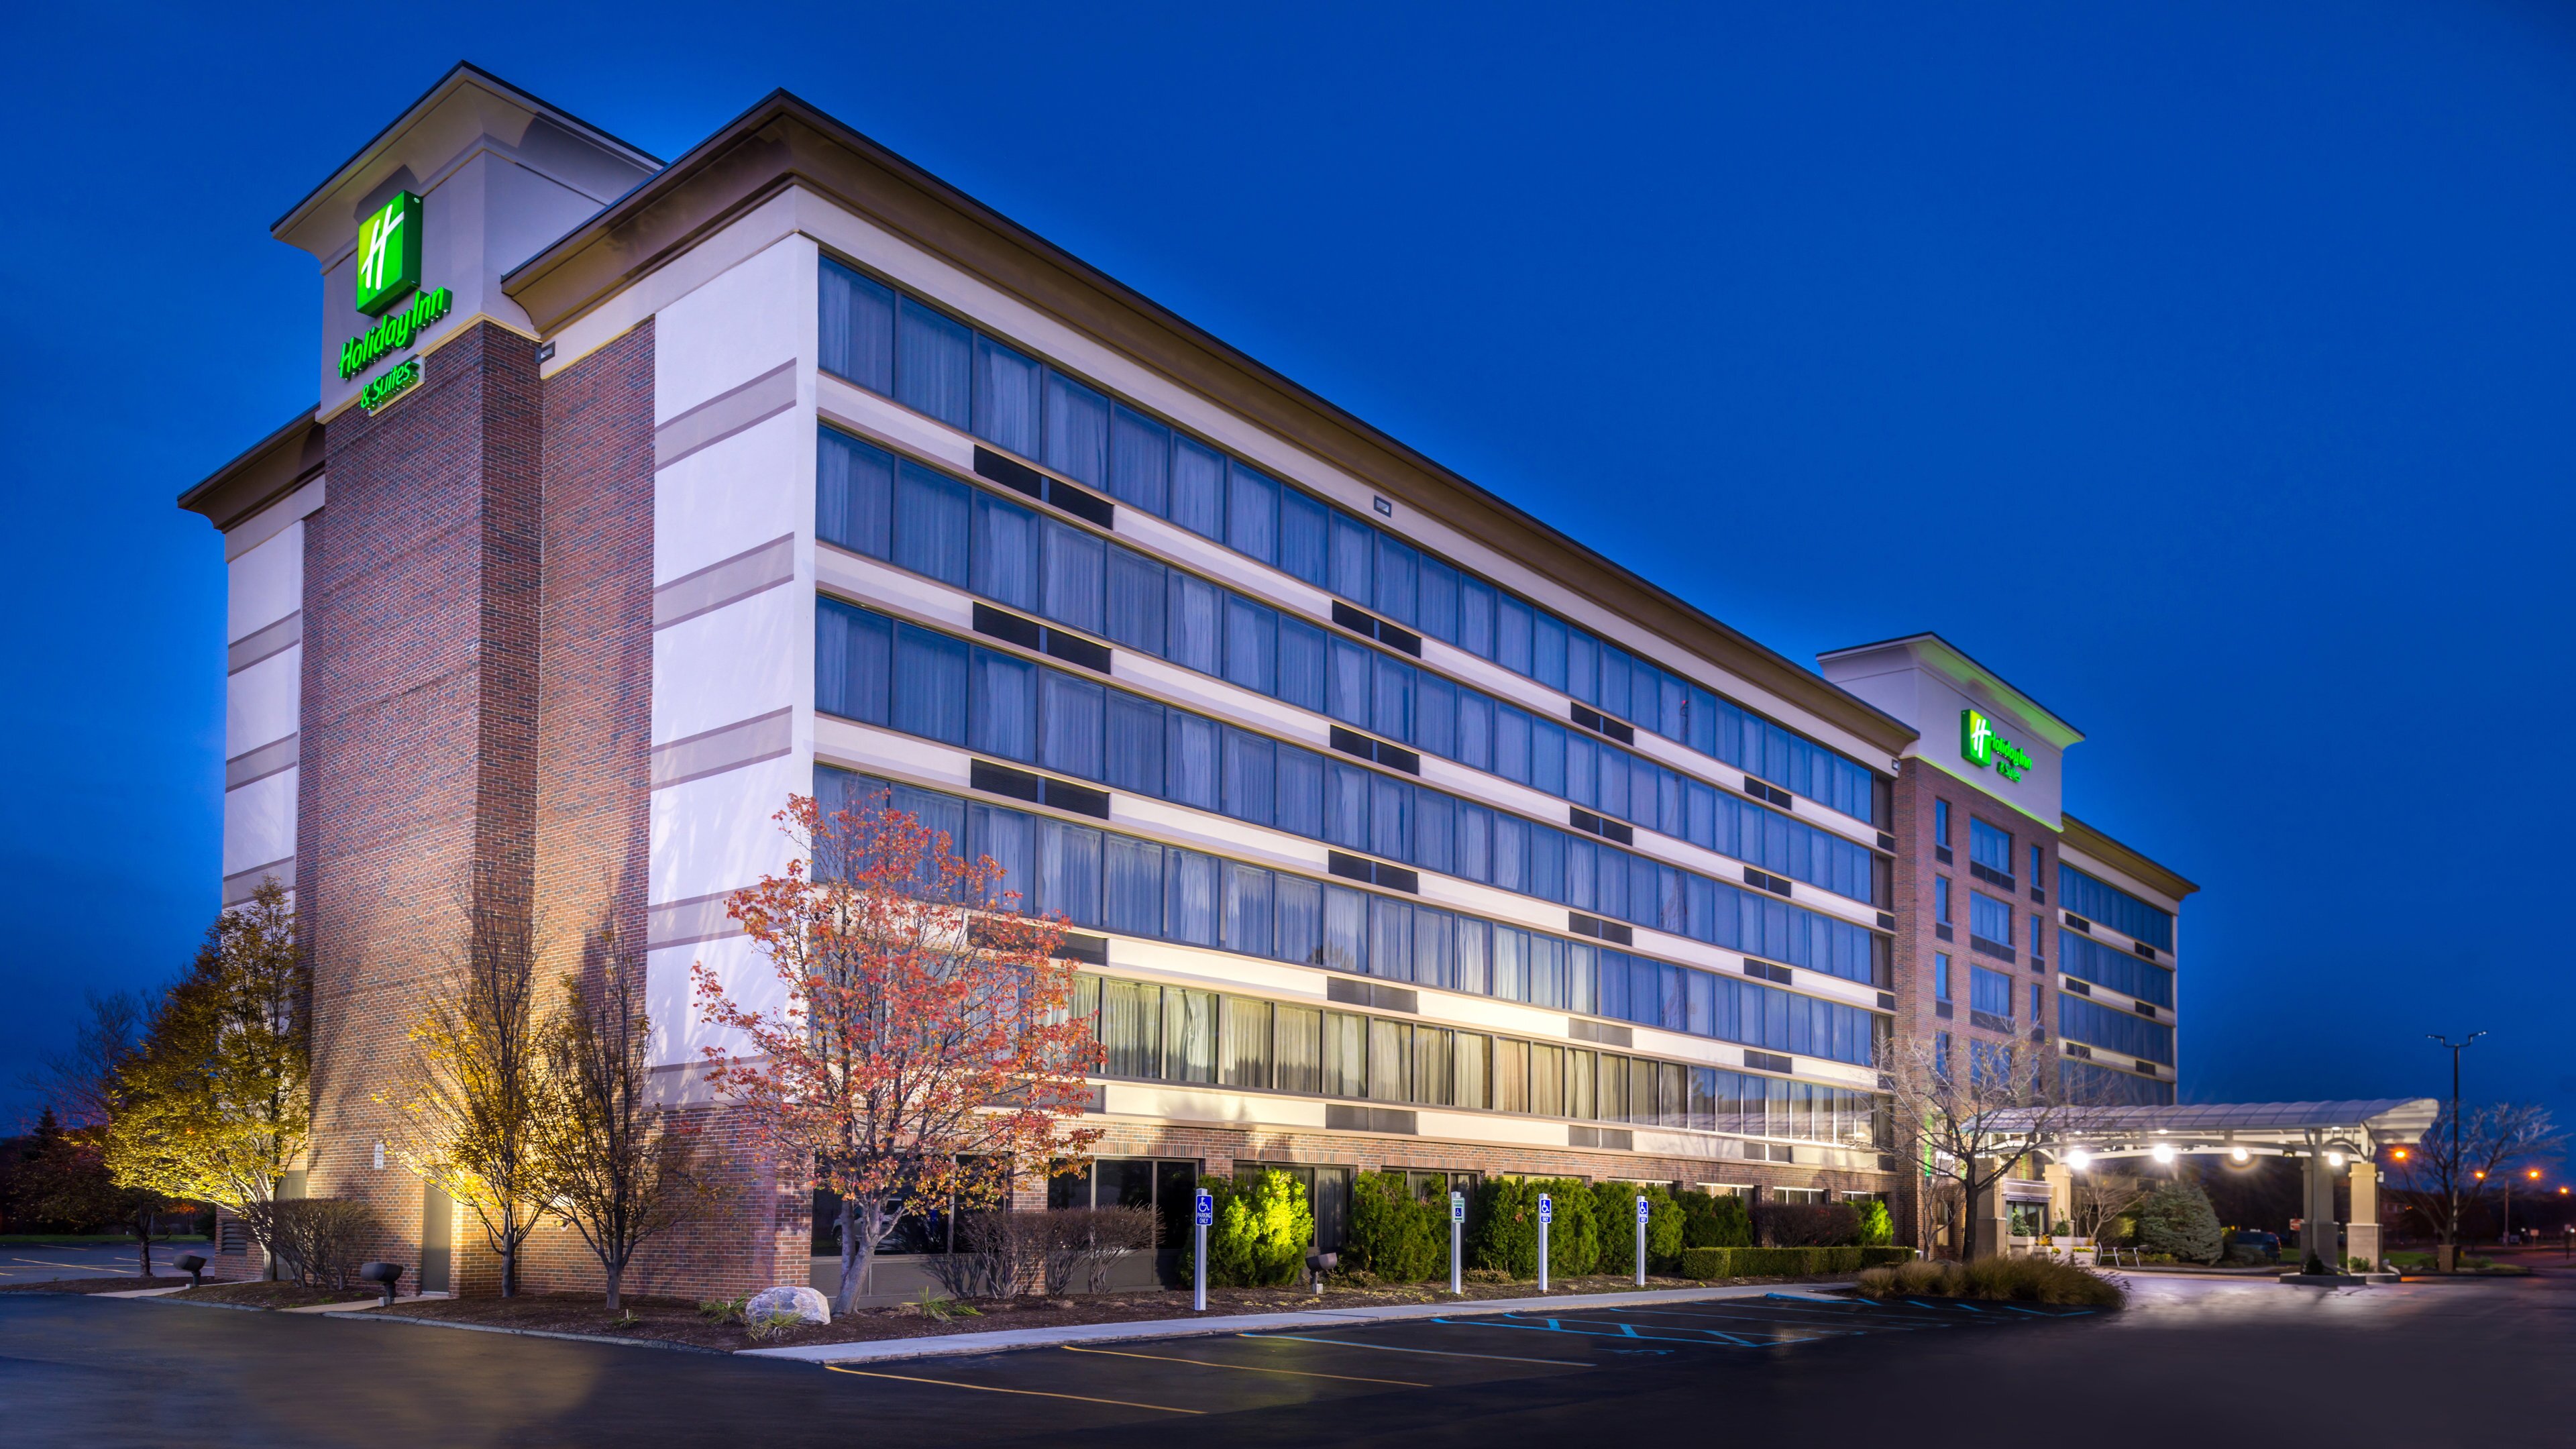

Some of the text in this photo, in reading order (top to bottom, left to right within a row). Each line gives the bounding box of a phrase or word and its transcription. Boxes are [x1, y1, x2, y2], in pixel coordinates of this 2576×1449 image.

[337, 286, 445, 379] Holiday Inn
[360, 360, 412, 409] & Suites
